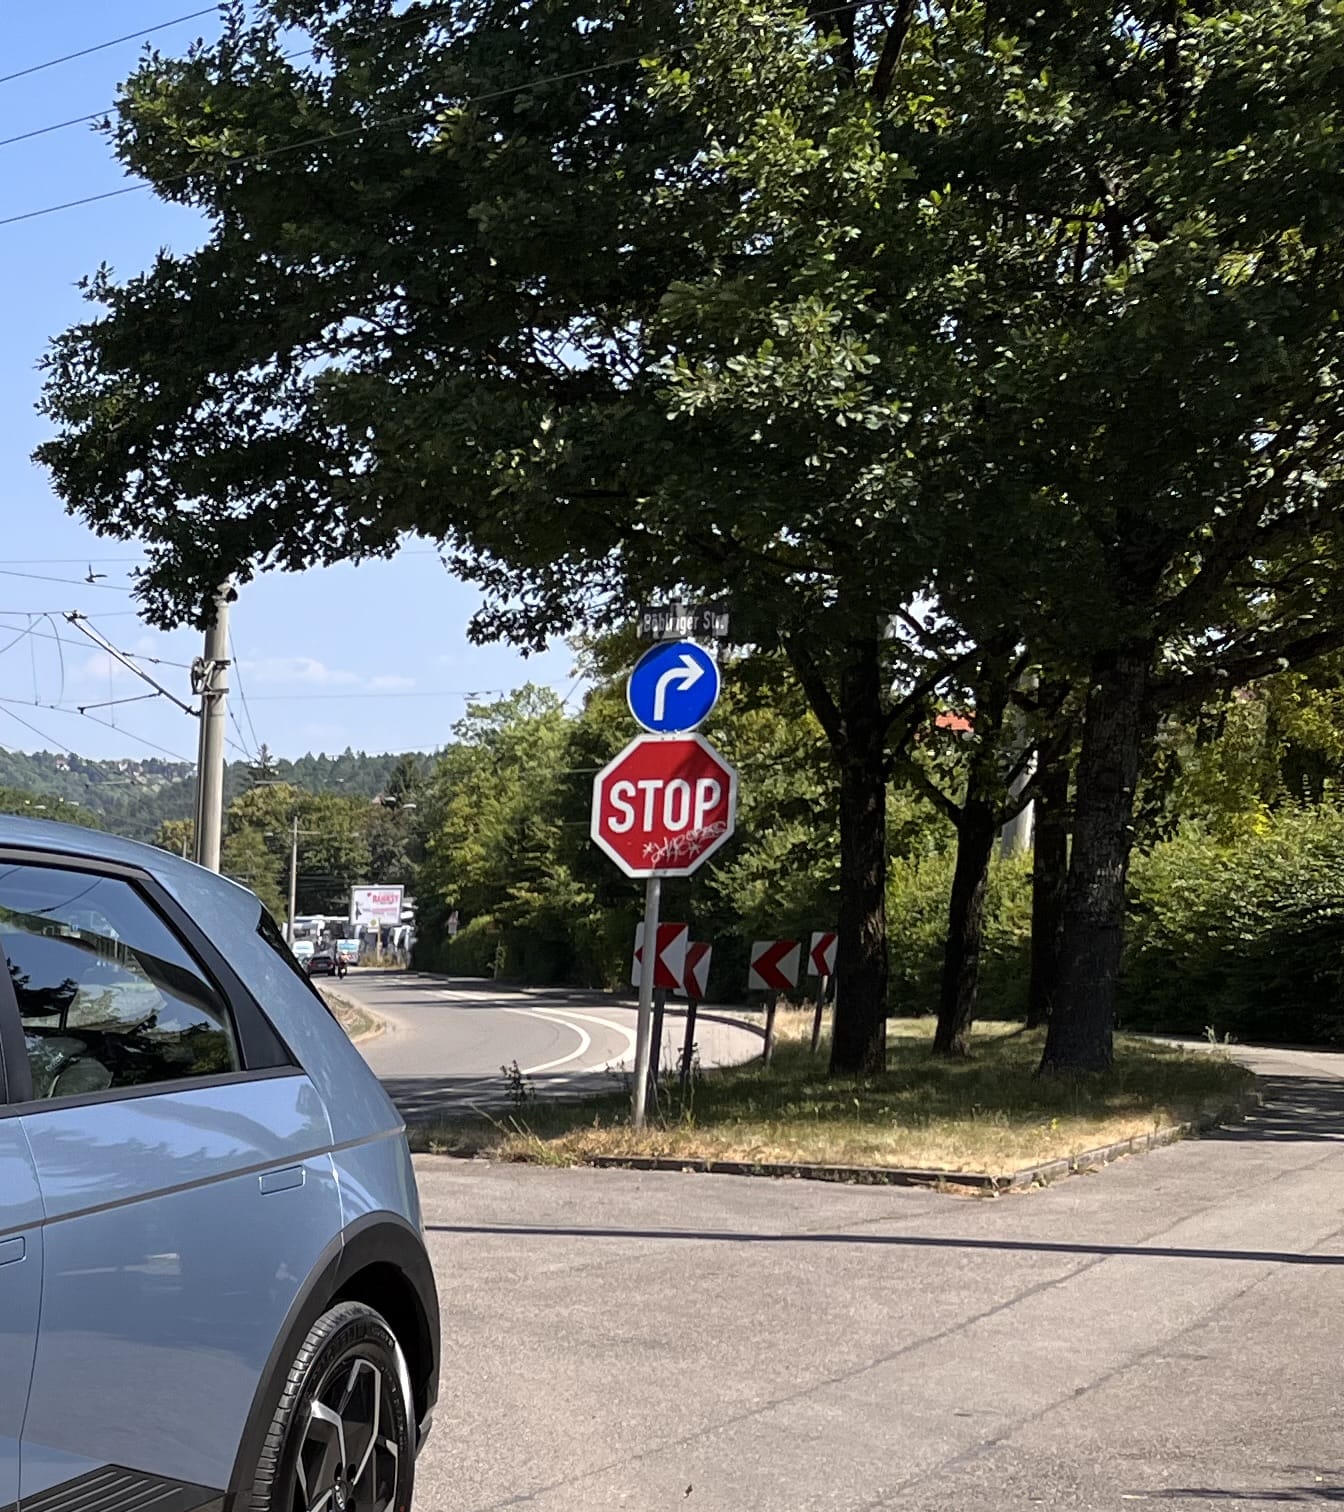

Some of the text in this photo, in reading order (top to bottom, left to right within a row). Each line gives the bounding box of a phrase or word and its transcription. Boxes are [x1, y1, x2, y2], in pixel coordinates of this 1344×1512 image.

[643, 611, 725, 636] Böblinger Str.
[608, 778, 721, 833] STOP
